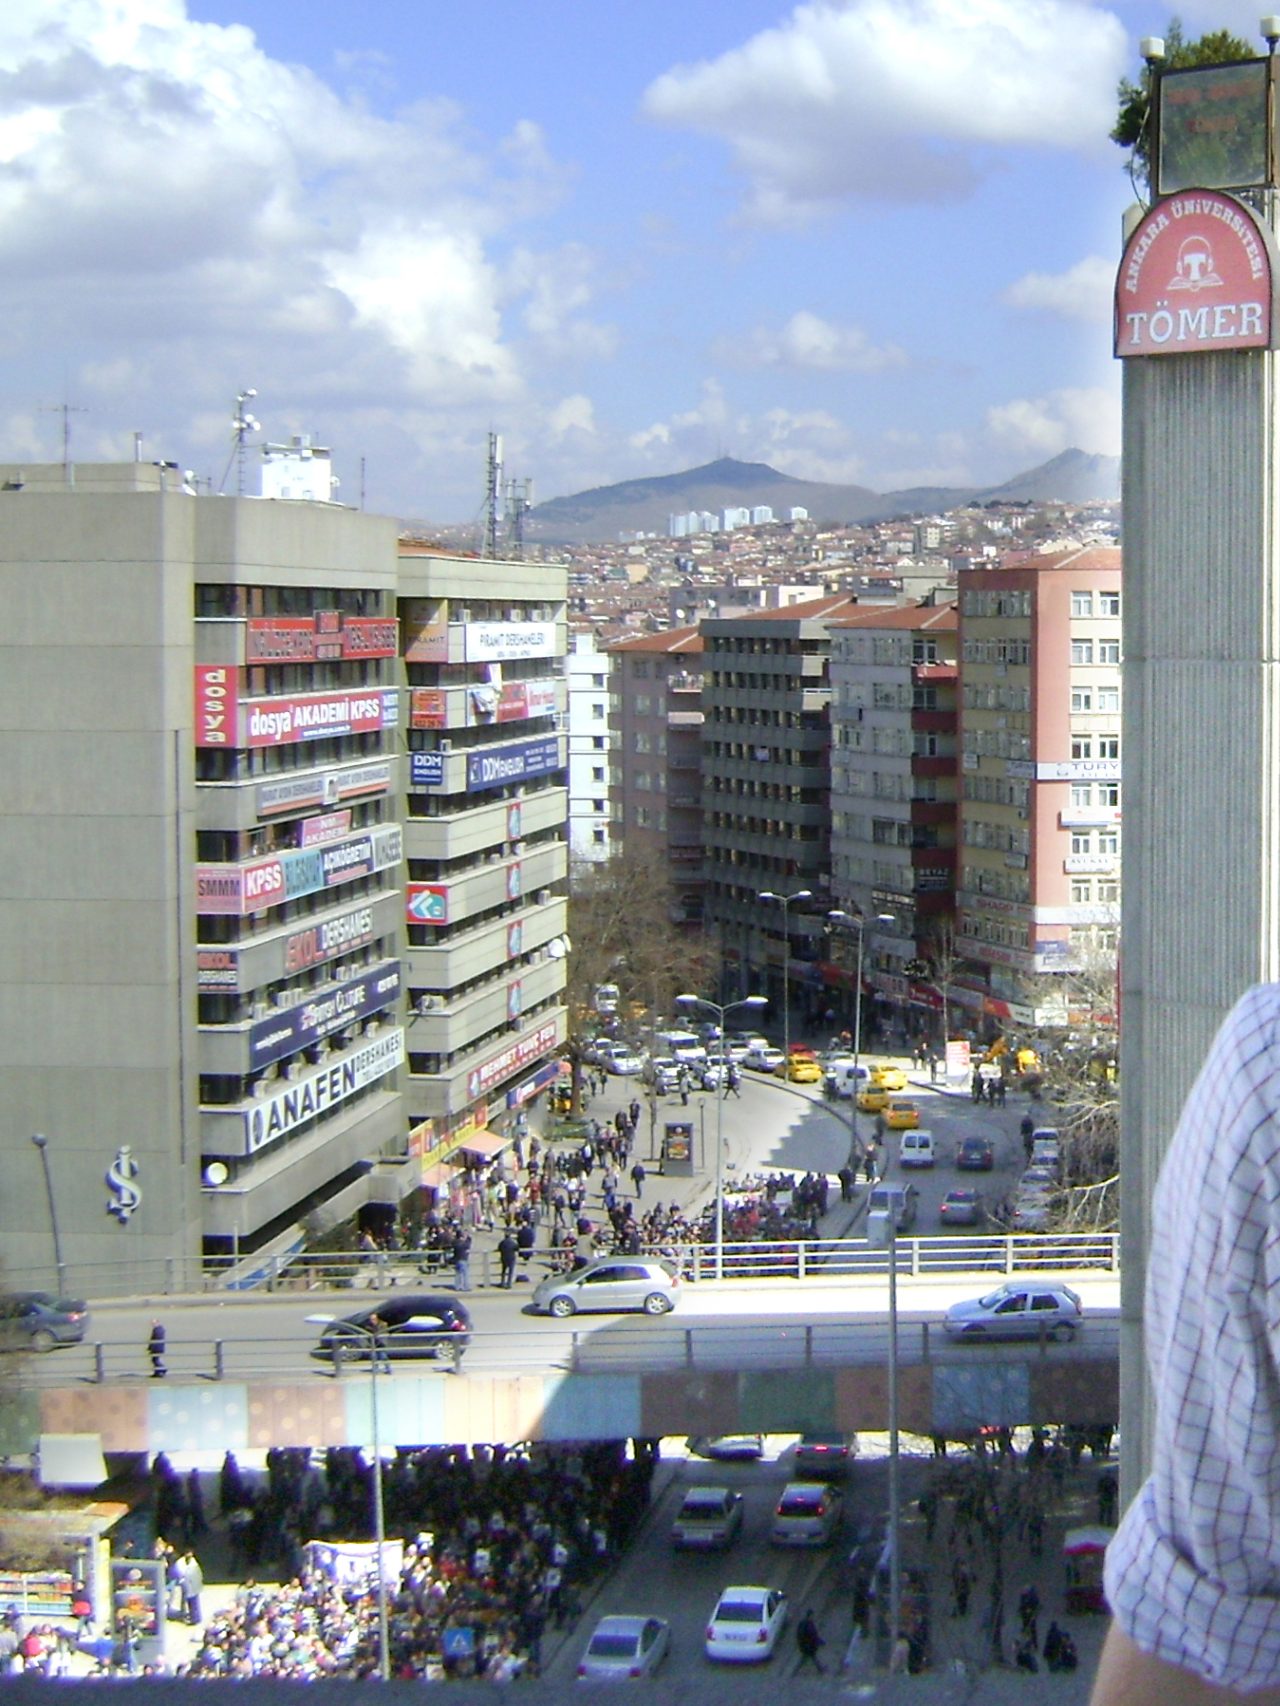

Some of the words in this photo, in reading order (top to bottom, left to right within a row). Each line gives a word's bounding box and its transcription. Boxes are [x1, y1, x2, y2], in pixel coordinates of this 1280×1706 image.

[1125, 214, 1170, 294] ANKARA
[1126, 301, 1263, 345] TÖMER
[204, 668, 228, 743] dosya
[250, 708, 291, 740] dosya
[351, 698, 380, 720] KPSS
[413, 754, 442, 767] DDM
[198, 879, 241, 897] SMMM
[246, 864, 282, 898] KPSS
[267, 1057, 355, 1139] ANAFEN
